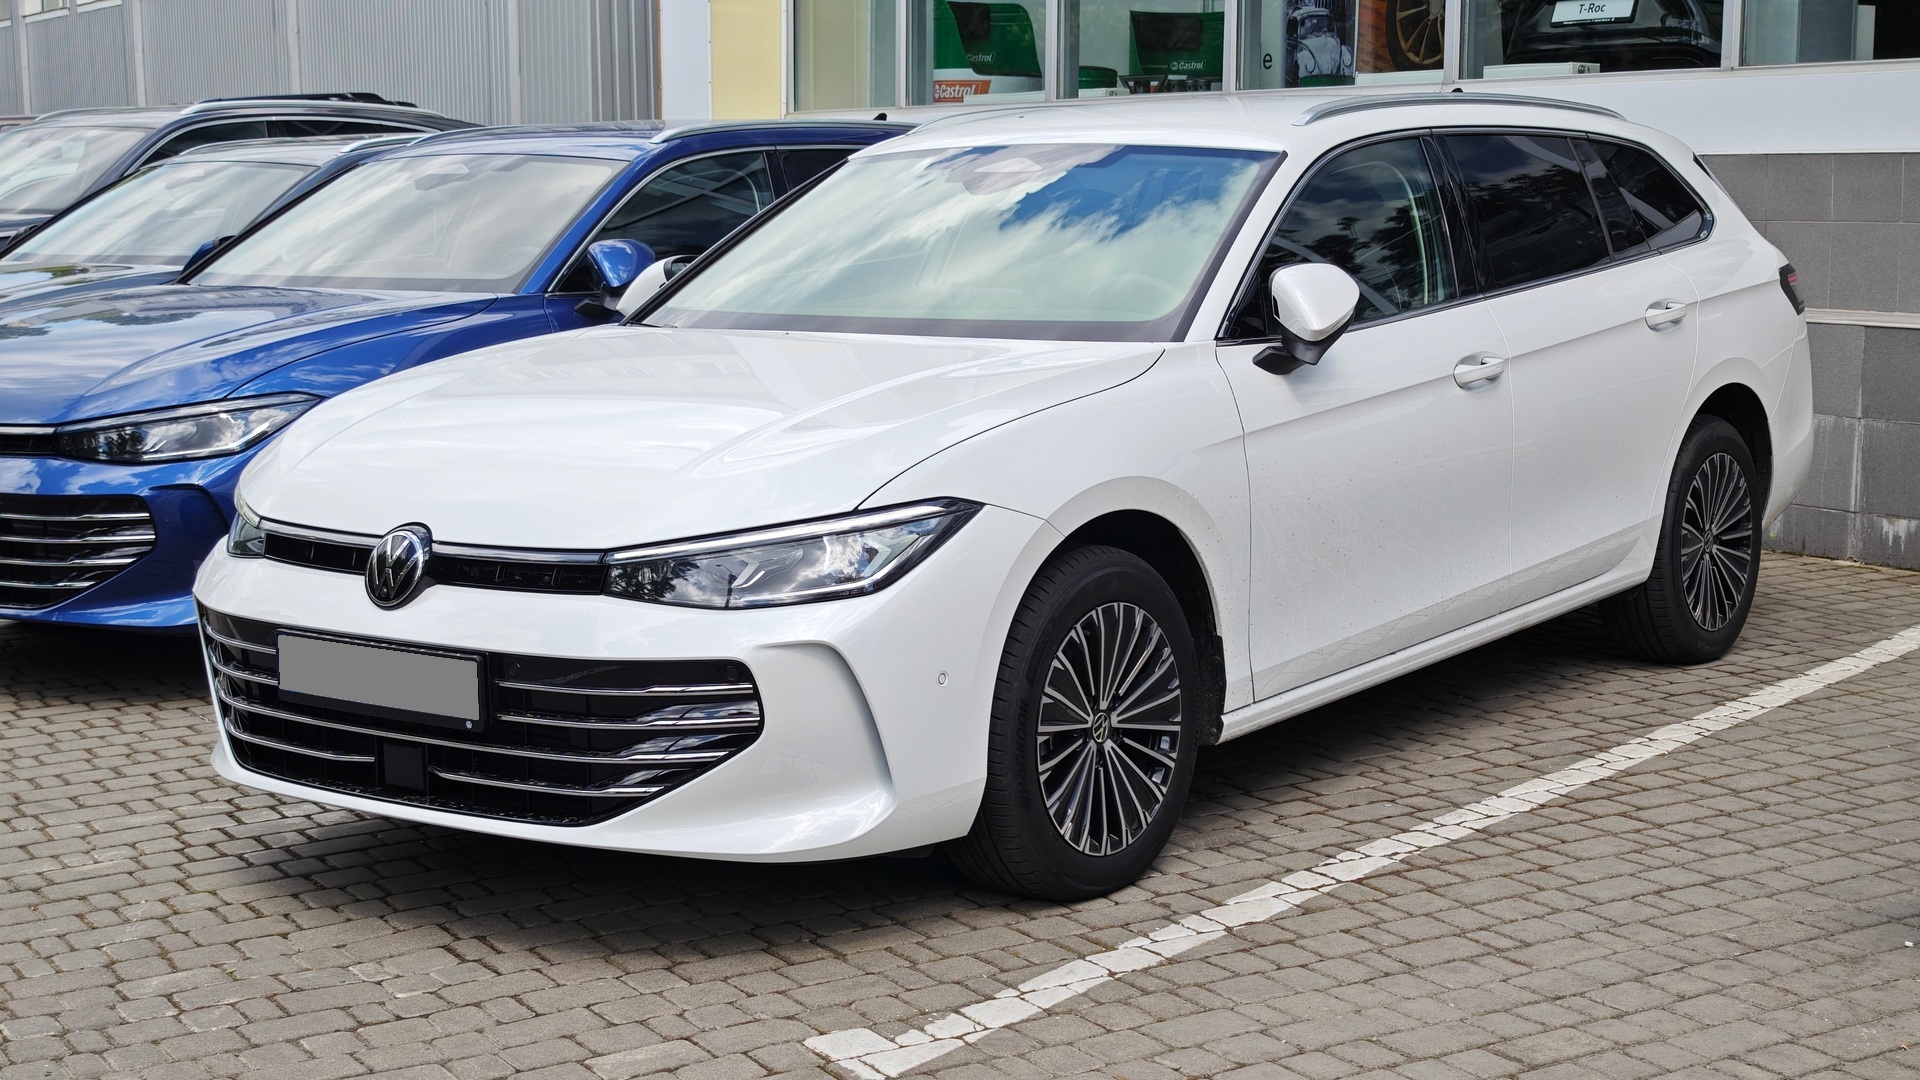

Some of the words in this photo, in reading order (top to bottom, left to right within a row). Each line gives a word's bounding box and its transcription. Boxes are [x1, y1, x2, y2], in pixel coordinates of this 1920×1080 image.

[1578, 3, 1607, 14] T-Roc
[966, 53, 993, 62] Castrol
[1179, 61, 1204, 71] Castrol
[939, 84, 976, 98] Castrol
